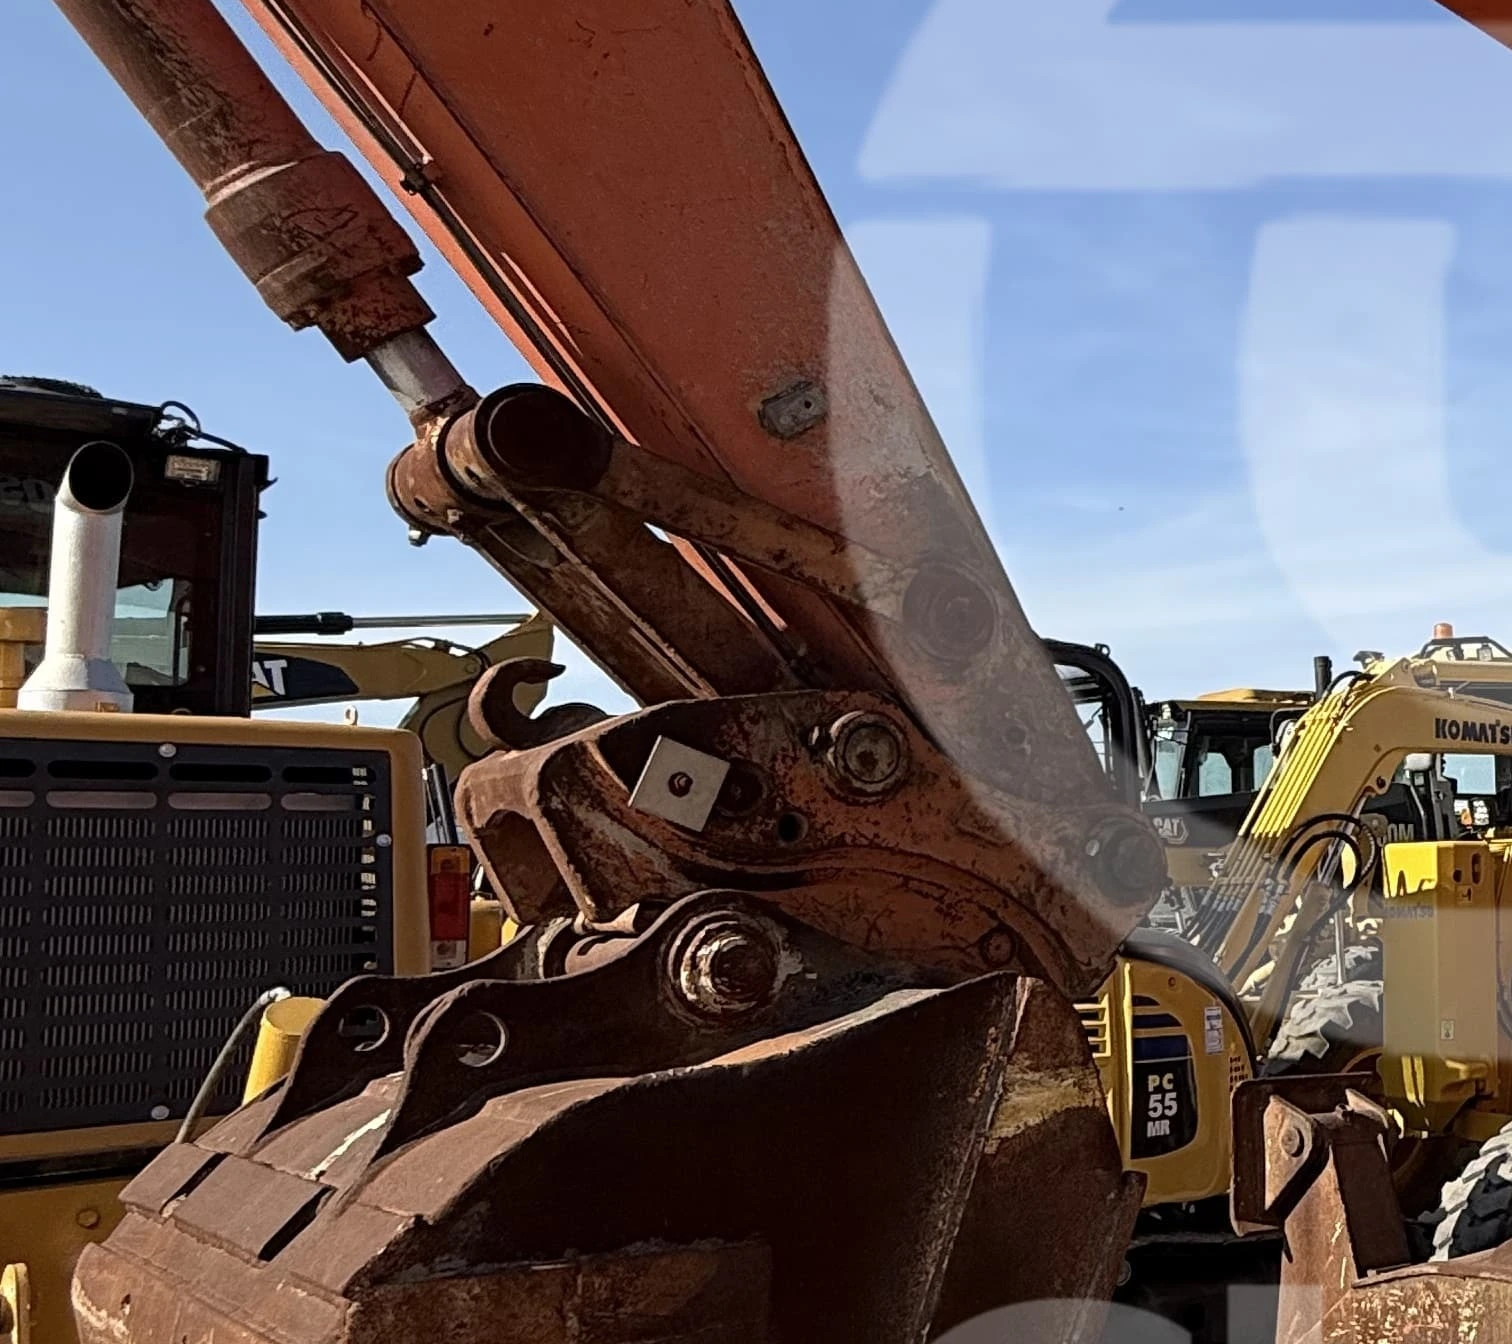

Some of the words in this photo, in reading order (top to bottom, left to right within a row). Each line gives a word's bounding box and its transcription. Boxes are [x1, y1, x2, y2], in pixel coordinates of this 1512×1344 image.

[252, 659, 288, 696] AT
[1148, 1072, 1175, 1092] PC
[1148, 1092, 1178, 1118] 55
[1146, 1119, 1171, 1138] MR
